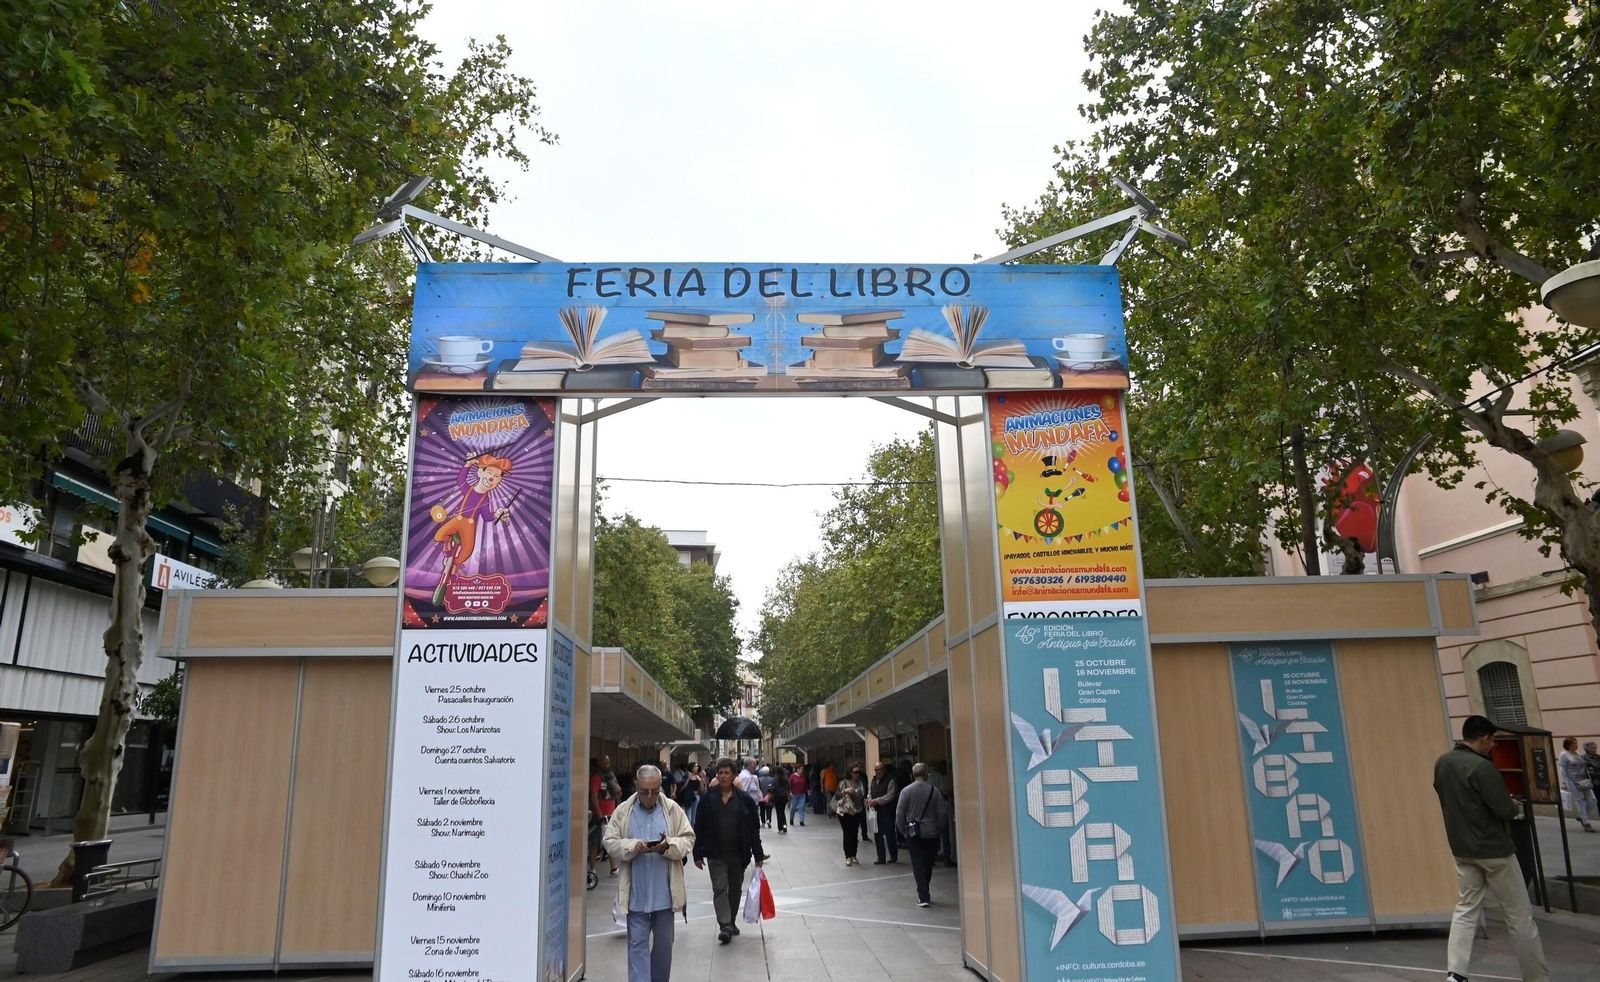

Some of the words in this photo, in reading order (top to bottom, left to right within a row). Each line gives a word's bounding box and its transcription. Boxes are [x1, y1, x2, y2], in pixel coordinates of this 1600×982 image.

[567, 267, 707, 298] FERIA
[723, 267, 813, 298] DEL
[830, 266, 971, 298] LIBRO
[450, 403, 526, 425] ANIMACIONES
[1004, 404, 1103, 432] ANIMACIONES
[448, 413, 530, 441] MUNDAFA
[1003, 419, 1111, 455] MUNDAFA
[1033, 550, 1060, 558] CASTILLOS
[1101, 545, 1119, 553] MUCHO
[1010, 564, 1128, 575] www.animacionesmundafa.com
[173, 569, 208, 589] AVILÉS
[1012, 576, 1064, 585] 957630326
[1067, 575, 1073, 584] /
[1075, 575, 1126, 583] 619380440
[1012, 585, 1129, 596] info@animacionesmundafa.com
[1043, 624, 1074, 632] EDICIÓN
[1037, 637, 1082, 651] Antiguo
[1098, 636, 1137, 648] Ocasión
[407, 643, 538, 663] ACTIVIDADES
[1086, 659, 1127, 667] OCTUBRE
[1086, 668, 1137, 676] NOVIEMBRE
[424, 685, 448, 693] Viernes
[449, 685, 461, 693] 25
[462, 685, 486, 693] octubre
[1095, 688, 1121, 697] Capitán
[438, 695, 472, 703] Pasacalles
[473, 695, 514, 705] Inauguración
[422, 715, 448, 723] Sábado
[448, 715, 460, 723] 26
[461, 715, 485, 723] octubre
[436, 725, 456, 734] Show:
[470, 725, 500, 733] Narizotas
[420, 745, 449, 756] Domingo
[450, 745, 462, 754] 27
[462, 745, 486, 754] octubre
[434, 756, 457, 764] Cuenta
[458, 756, 483, 764] cuentos
[483, 756, 515, 764] Salvatorix
[419, 787, 443, 795] Viernes
[448, 786, 480, 795] noviembre
[433, 797, 450, 806] Taller
[450, 797, 458, 805] de
[459, 797, 495, 805] Globoflexia
[417, 818, 442, 826] Sábado
[443, 818, 449, 826] 2
[450, 817, 483, 826] noviembre
[431, 828, 451, 837] Show:
[451, 829, 485, 838] Narimagio
[414, 860, 440, 869] Sábado
[441, 860, 447, 868] 9
[447, 859, 481, 868] noviembre
[429, 871, 449, 880] Show:
[449, 871, 473, 879] Chachi
[474, 870, 489, 879] Zoo
[412, 892, 442, 903] Domingo
[443, 892, 452, 901] 10
[452, 891, 487, 901] noviembre
[427, 903, 456, 911] Miniferia
[410, 936, 436, 944] Viernes
[437, 935, 446, 944] 15
[446, 935, 480, 944] noviembre
[424, 946, 444, 955] Zona
[444, 947, 453, 955] de
[454, 946, 479, 957] Juegos
[1082, 961, 1146, 970] cultura.cordoba.es
[408, 969, 434, 978] Sábado
[435, 969, 444, 978] 16
[445, 968, 480, 978] noviembre
